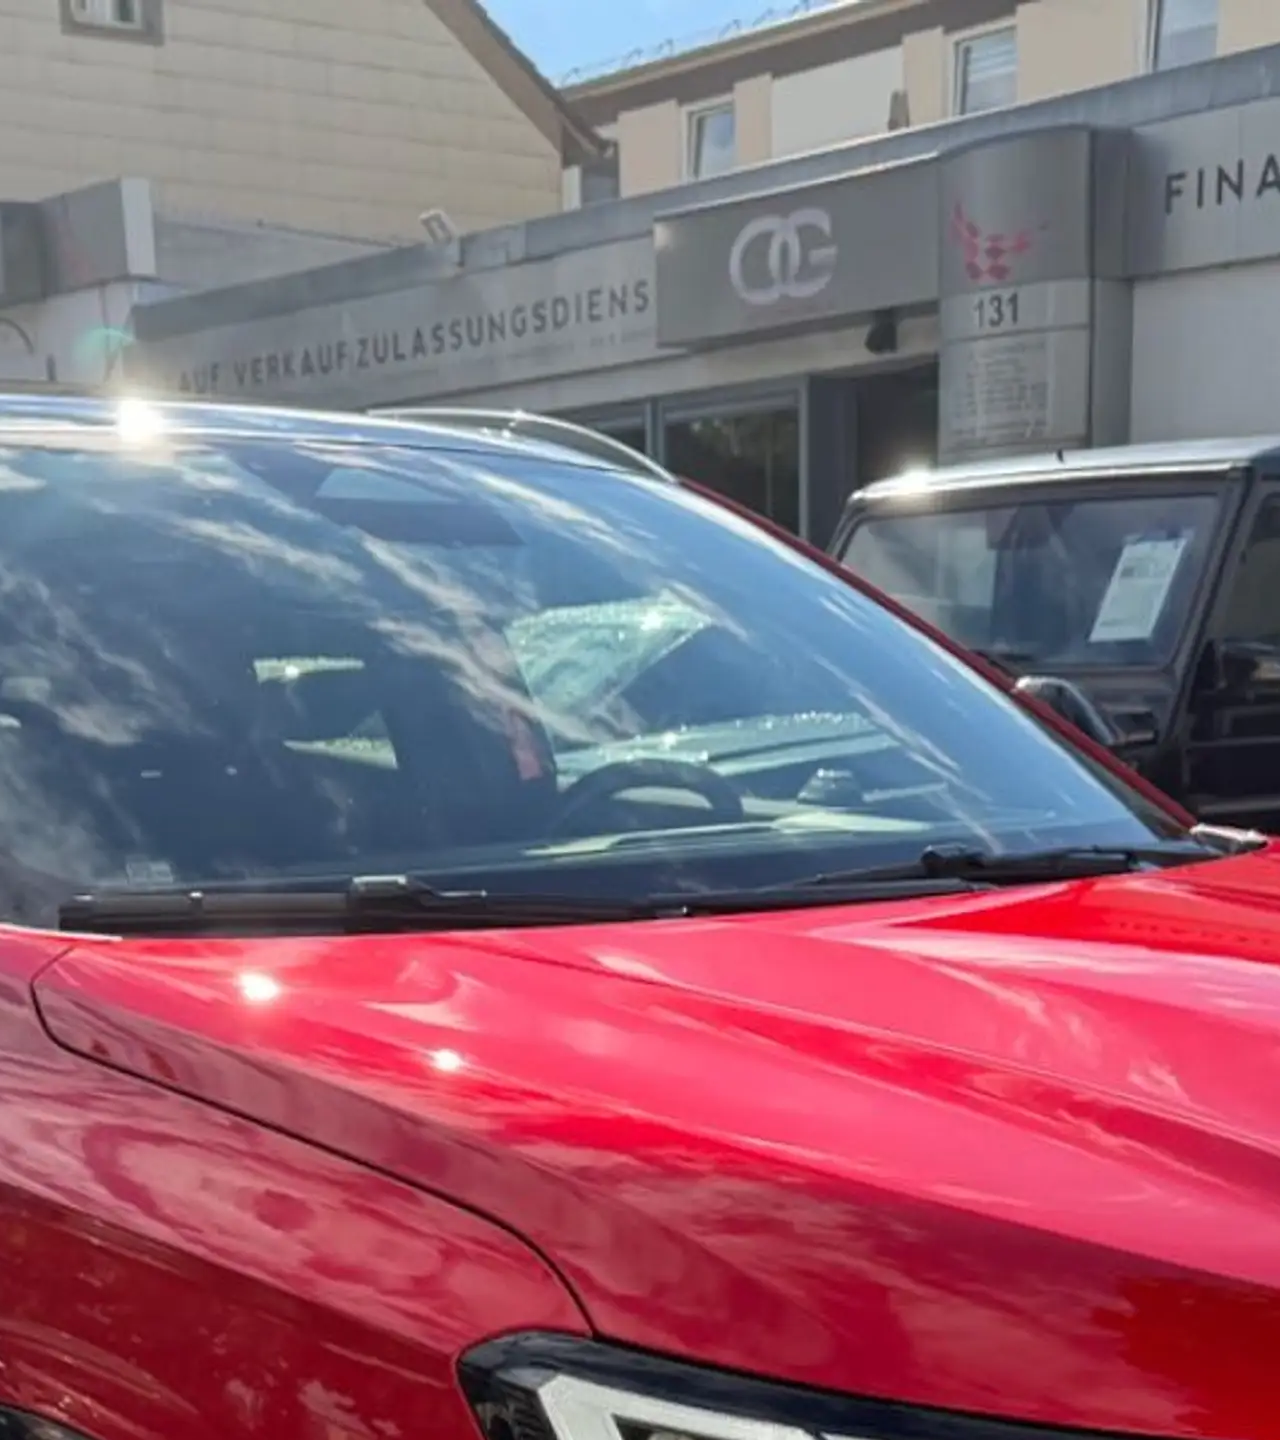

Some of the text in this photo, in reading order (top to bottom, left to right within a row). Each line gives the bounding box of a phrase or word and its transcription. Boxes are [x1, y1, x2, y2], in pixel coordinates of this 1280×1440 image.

[233, 340, 348, 388] VERKAUF
[356, 280, 650, 369] ZULASSUNGSDIENS
[973, 292, 1019, 329] 131
